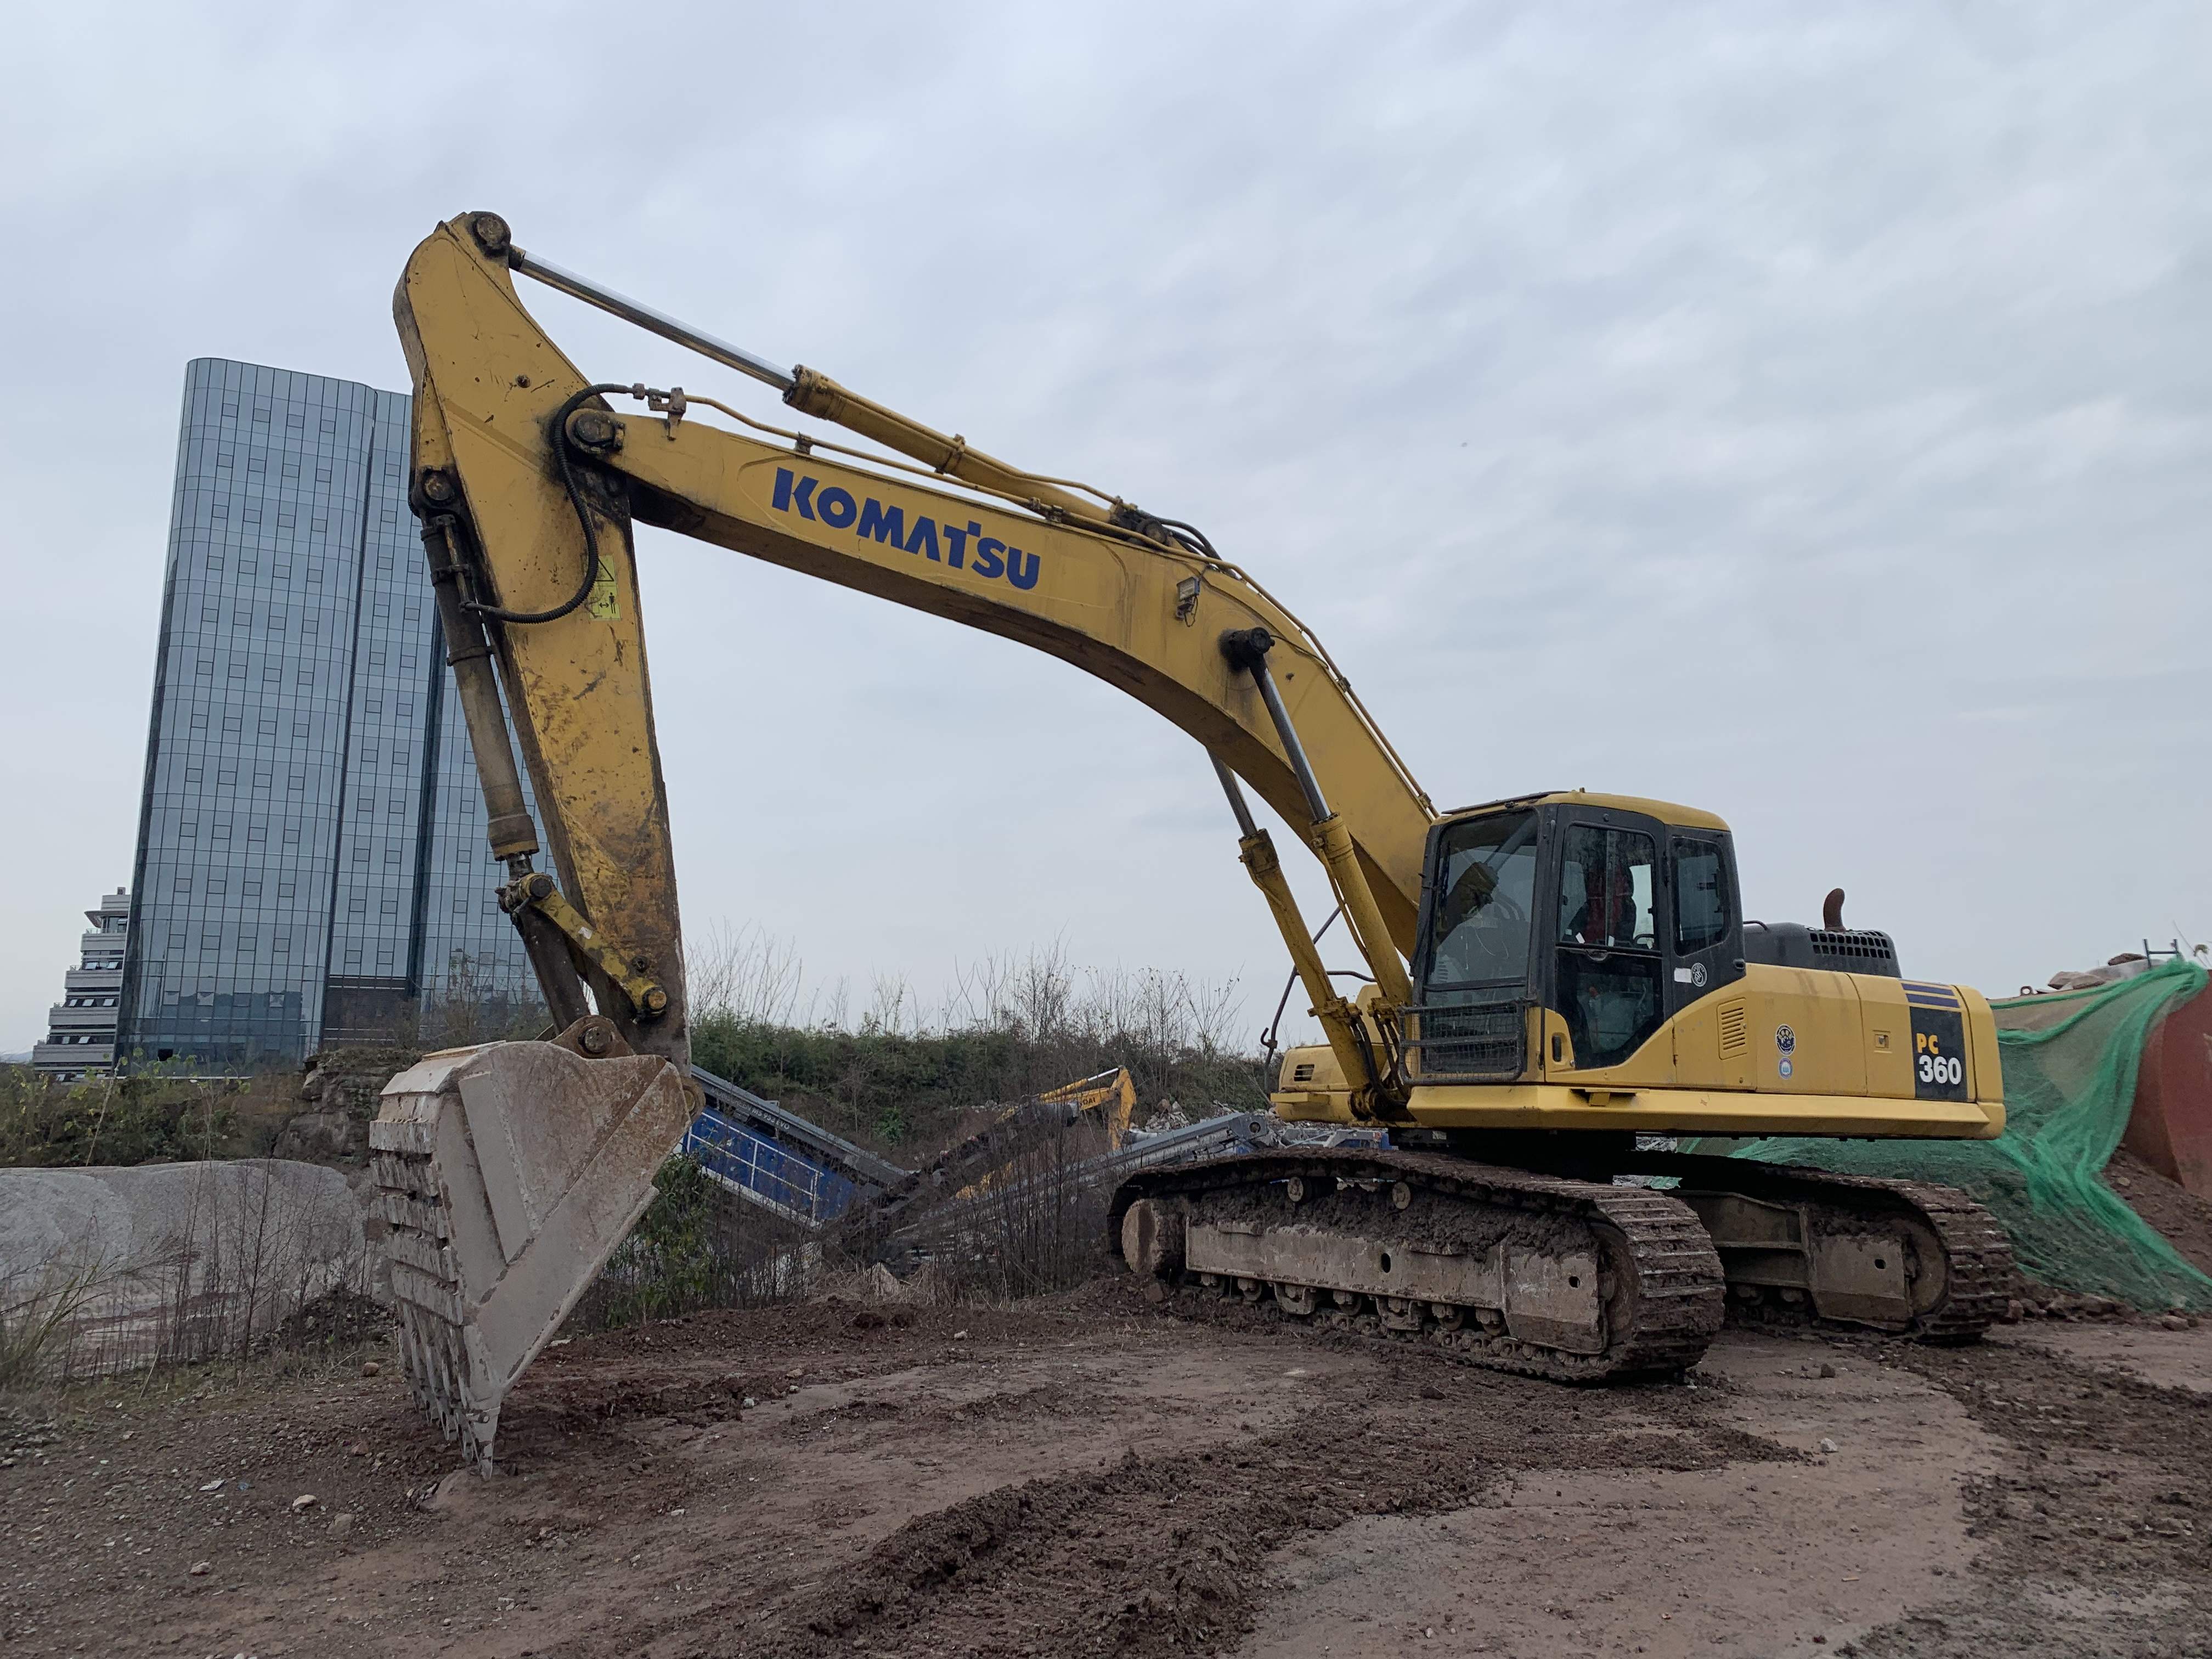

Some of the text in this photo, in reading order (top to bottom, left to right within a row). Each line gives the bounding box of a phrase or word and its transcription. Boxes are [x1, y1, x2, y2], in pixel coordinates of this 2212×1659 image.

[771, 466, 1041, 590] KOMATSU
[1916, 1033, 1939, 1054] PC
[1919, 1054, 1962, 1085] 360
